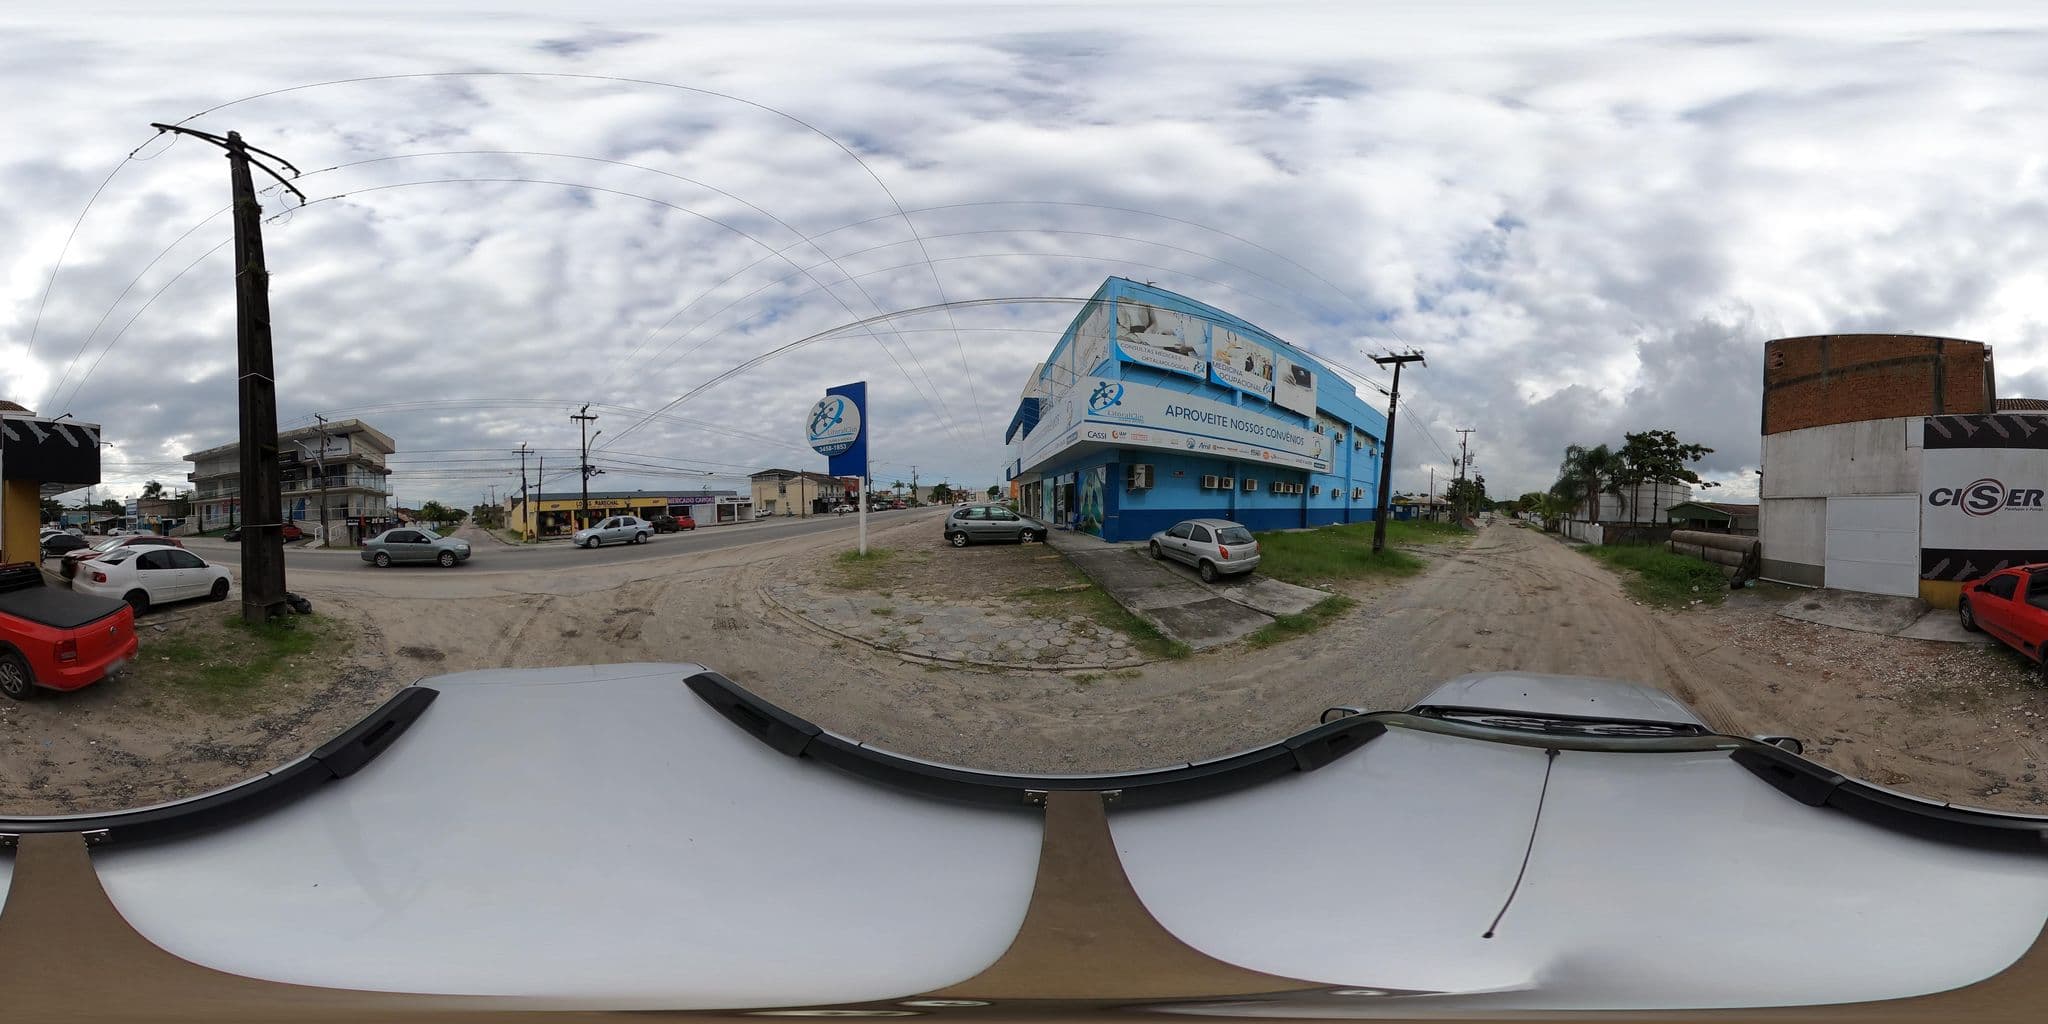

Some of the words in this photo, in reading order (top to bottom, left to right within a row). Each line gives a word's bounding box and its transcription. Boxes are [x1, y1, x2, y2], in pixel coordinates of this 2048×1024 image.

[1212, 361, 1243, 376] MEDICINA
[1219, 372, 1262, 392] OCUPACIONAL
[1087, 430, 1107, 439] CASSI
[1165, 404, 1228, 428] APROVEITE
[1230, 418, 1264, 435] NOSSOS
[1265, 428, 1304, 446] CONVÊNIOS
[1928, 486, 2044, 509] CISER
